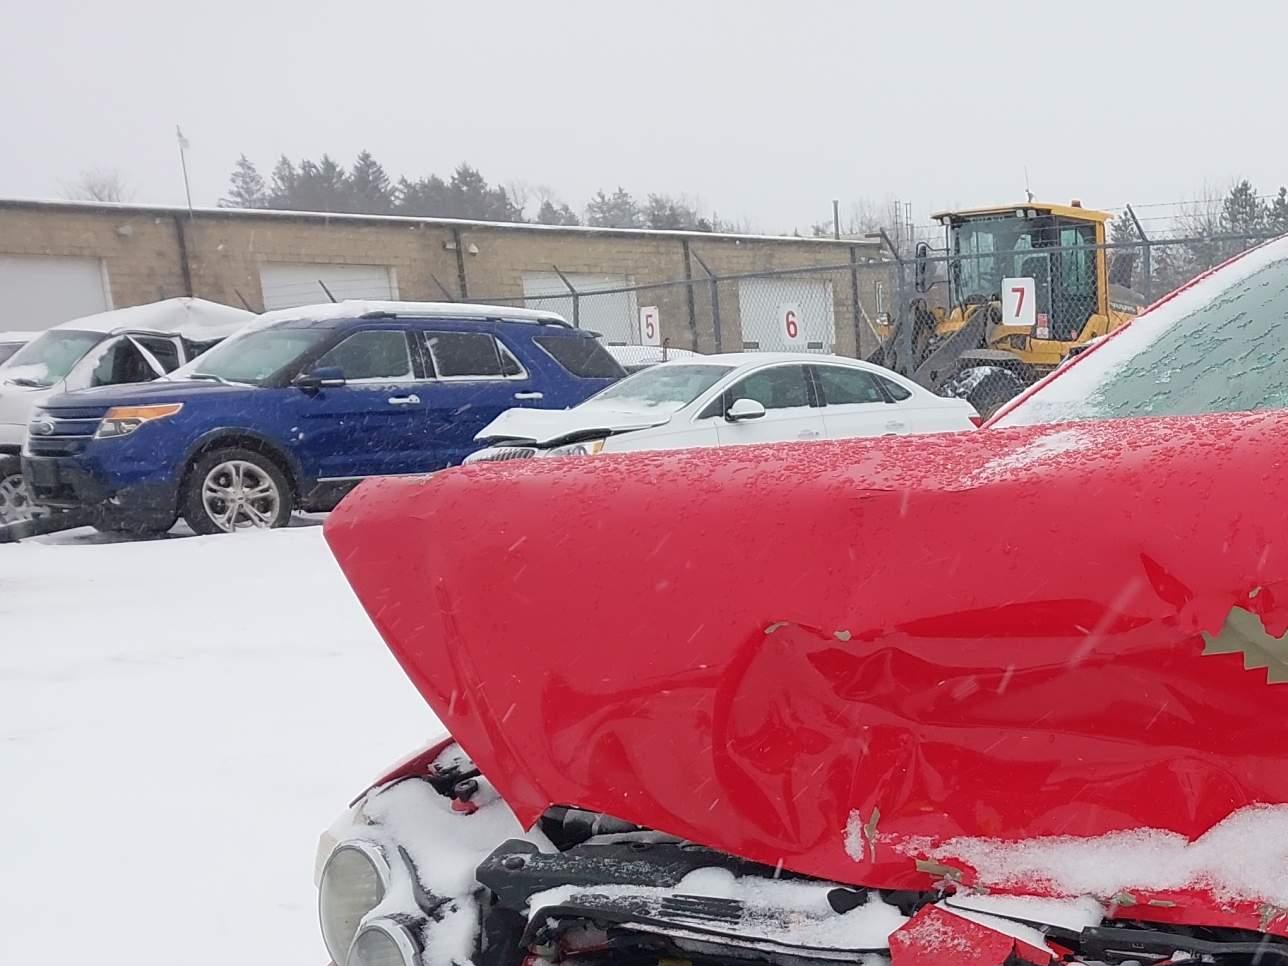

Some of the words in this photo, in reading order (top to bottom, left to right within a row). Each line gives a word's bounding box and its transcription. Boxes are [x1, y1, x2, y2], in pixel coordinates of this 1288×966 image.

[1011, 287, 1025, 317] 7
[645, 314, 655, 339] 5
[785, 310, 798, 338] 6
